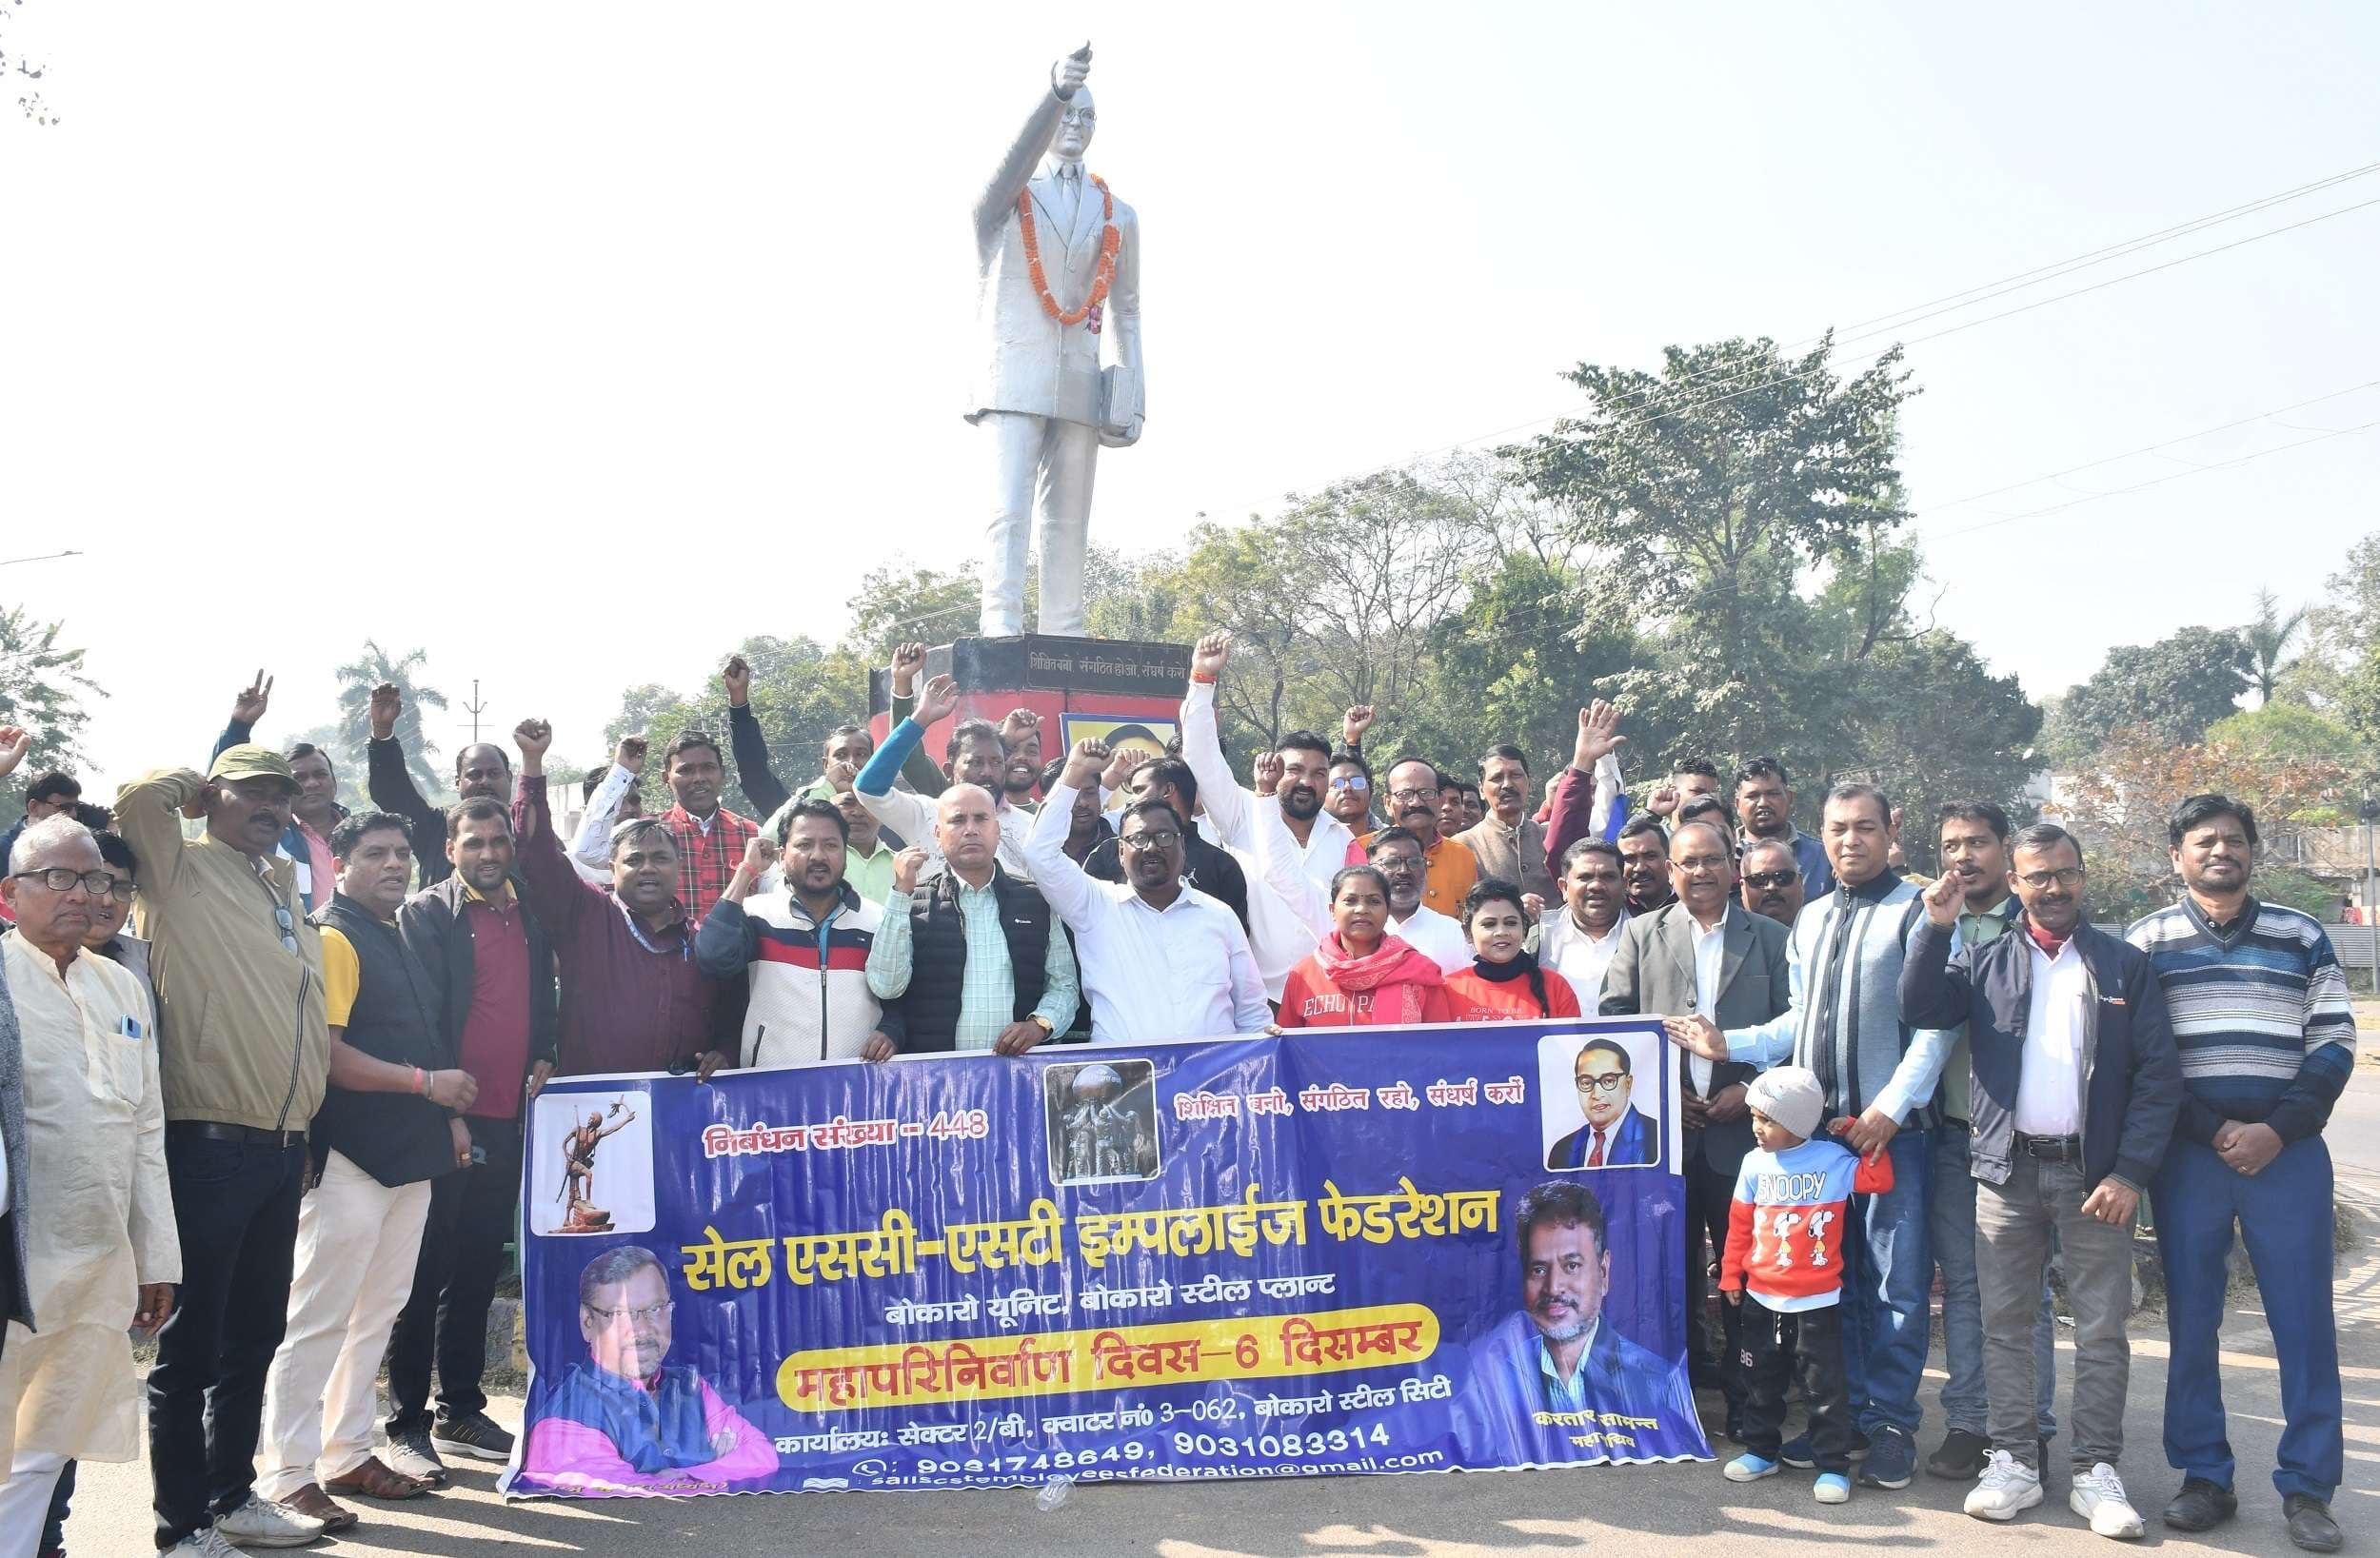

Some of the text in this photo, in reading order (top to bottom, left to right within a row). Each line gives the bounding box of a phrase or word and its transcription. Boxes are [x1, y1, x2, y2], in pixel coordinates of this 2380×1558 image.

[1302, 993, 1346, 1017] ECHO
[1300, 1082, 1369, 1113] संगठित
[1380, 1082, 1419, 1110] रहो,
[703, 1122, 808, 1157] निबंधन
[811, 1116, 897, 1148] संख्या
[927, 1110, 988, 1139] 448
[1757, 1172, 1827, 1202] SNOOPY
[681, 1225, 775, 1291] सेल
[1076, 1184, 1306, 1268] इम्पलाईज
[1317, 1176, 1501, 1244] फेडरेशन
[884, 1272, 1337, 1328] बोकारो यूनिट, बोकारो स्टील प्लान्ट
[794, 1337, 1072, 1406] महापरिनिर्वाण
[1279, 1316, 1424, 1366] दिसम्बर
[1740, 1349, 1753, 1368] 86
[897, 1421, 968, 1446] सेक्टर
[1253, 1390, 1334, 1418] बोकारो
[1339, 1383, 1396, 1410] स्टील
[1399, 1375, 1452, 1402] सिटी
[1172, 1423, 1390, 1457] 9031083314
